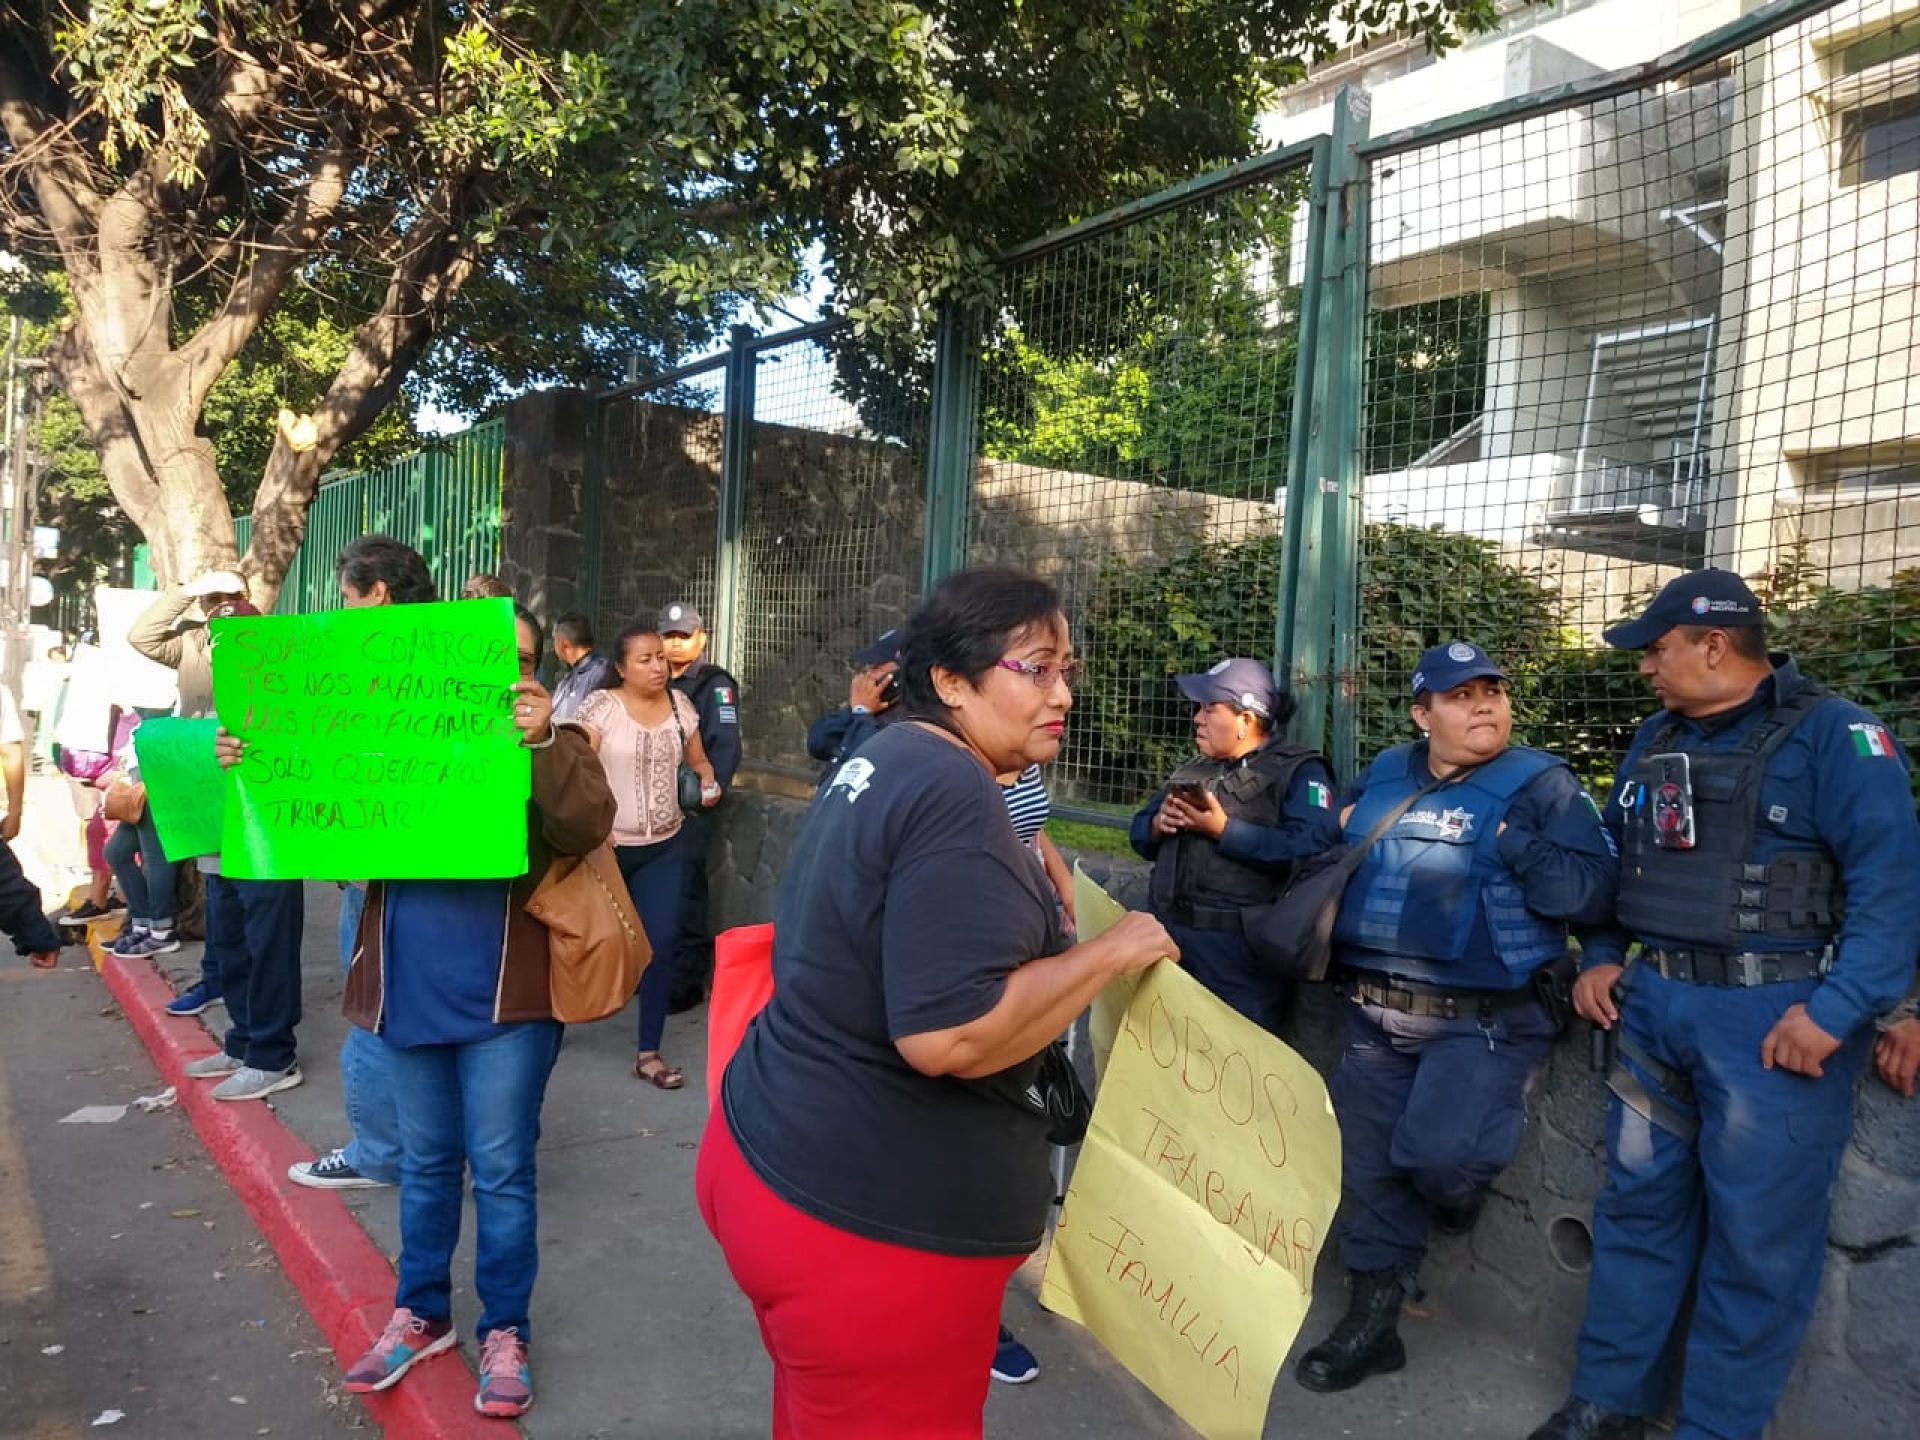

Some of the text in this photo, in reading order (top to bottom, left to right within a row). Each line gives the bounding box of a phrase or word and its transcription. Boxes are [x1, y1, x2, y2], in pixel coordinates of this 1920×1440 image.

[234, 629, 336, 671] SOMOS
[239, 672, 289, 695] TES
[304, 672, 351, 697] NOS
[249, 750, 314, 784] SOLO
[1142, 1107, 1316, 1296] TRABAJAR
[1088, 1215, 1241, 1398] FAMILIA
